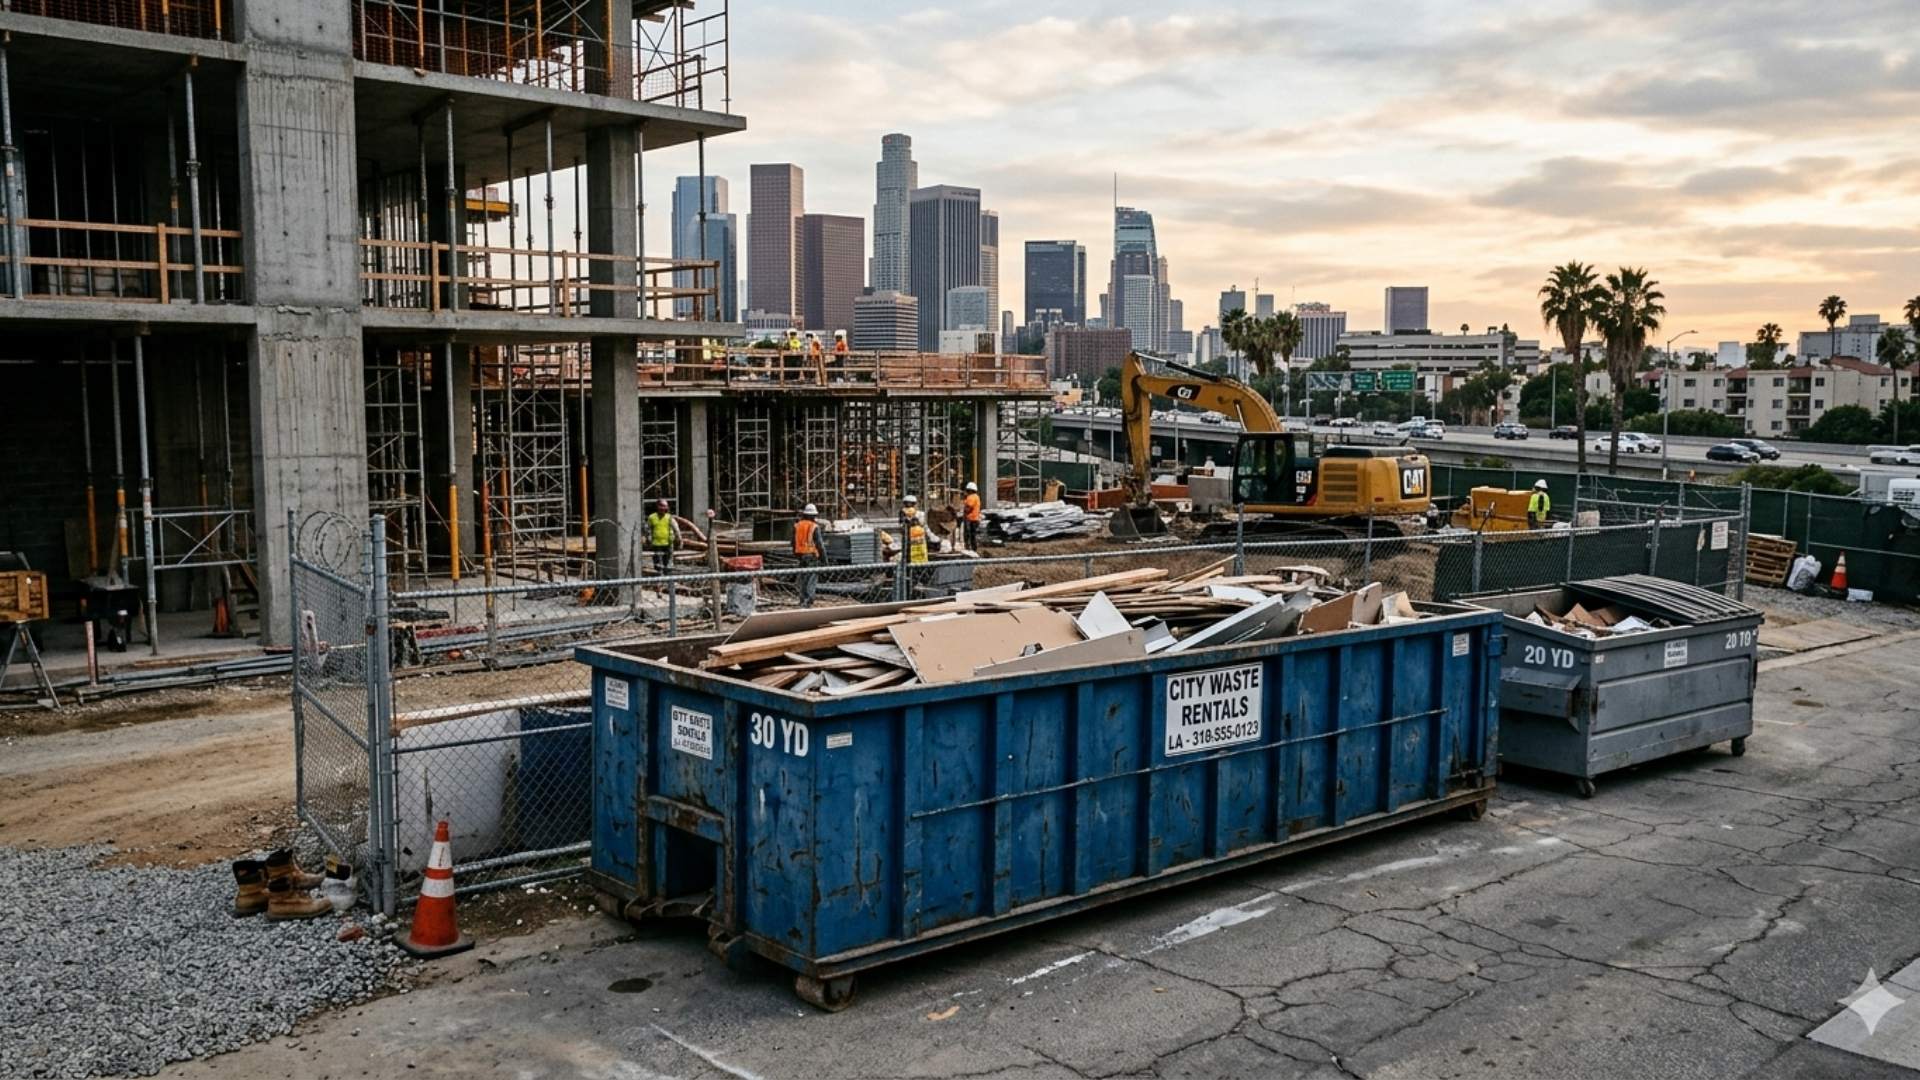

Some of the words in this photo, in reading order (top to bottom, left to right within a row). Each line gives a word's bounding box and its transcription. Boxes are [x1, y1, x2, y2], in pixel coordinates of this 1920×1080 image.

[1403, 468, 1424, 494] CAT
[1725, 632, 1737, 650] 20
[1524, 644, 1547, 665] 20
[1551, 647, 1574, 669] YD
[1170, 676, 1205, 701] CITY
[1210, 668, 1258, 695] WASTE
[1182, 695, 1248, 726] RENTALS
[751, 711, 775, 750] 30
[780, 718, 809, 758] YD
[1168, 733, 1183, 750] LA
